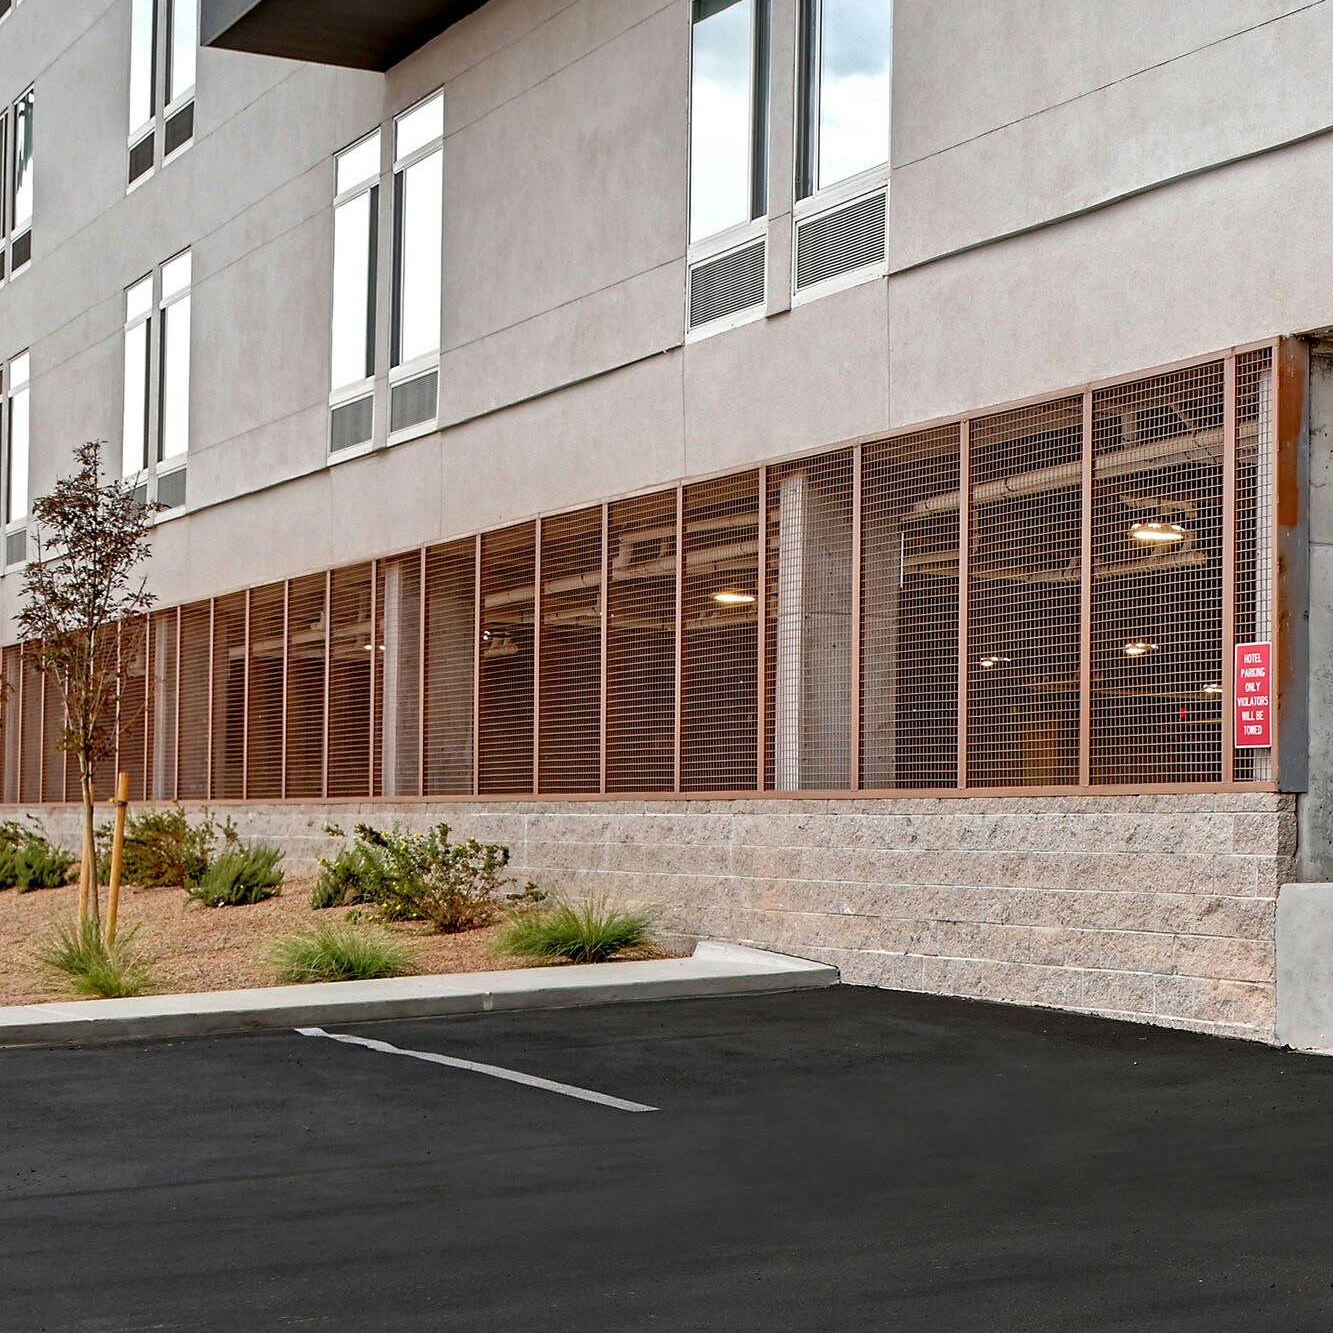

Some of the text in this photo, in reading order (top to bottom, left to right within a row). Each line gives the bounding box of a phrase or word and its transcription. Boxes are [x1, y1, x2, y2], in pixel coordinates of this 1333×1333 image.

[1243, 653, 1262, 664] HOTEL
[1240, 667, 1266, 678] PARKING
[1244, 681, 1261, 692] ONLY
[1237, 695, 1269, 707] VIOLATORS
[1241, 710, 1264, 721] WILL BE
[1243, 724, 1262, 736] TOWED
